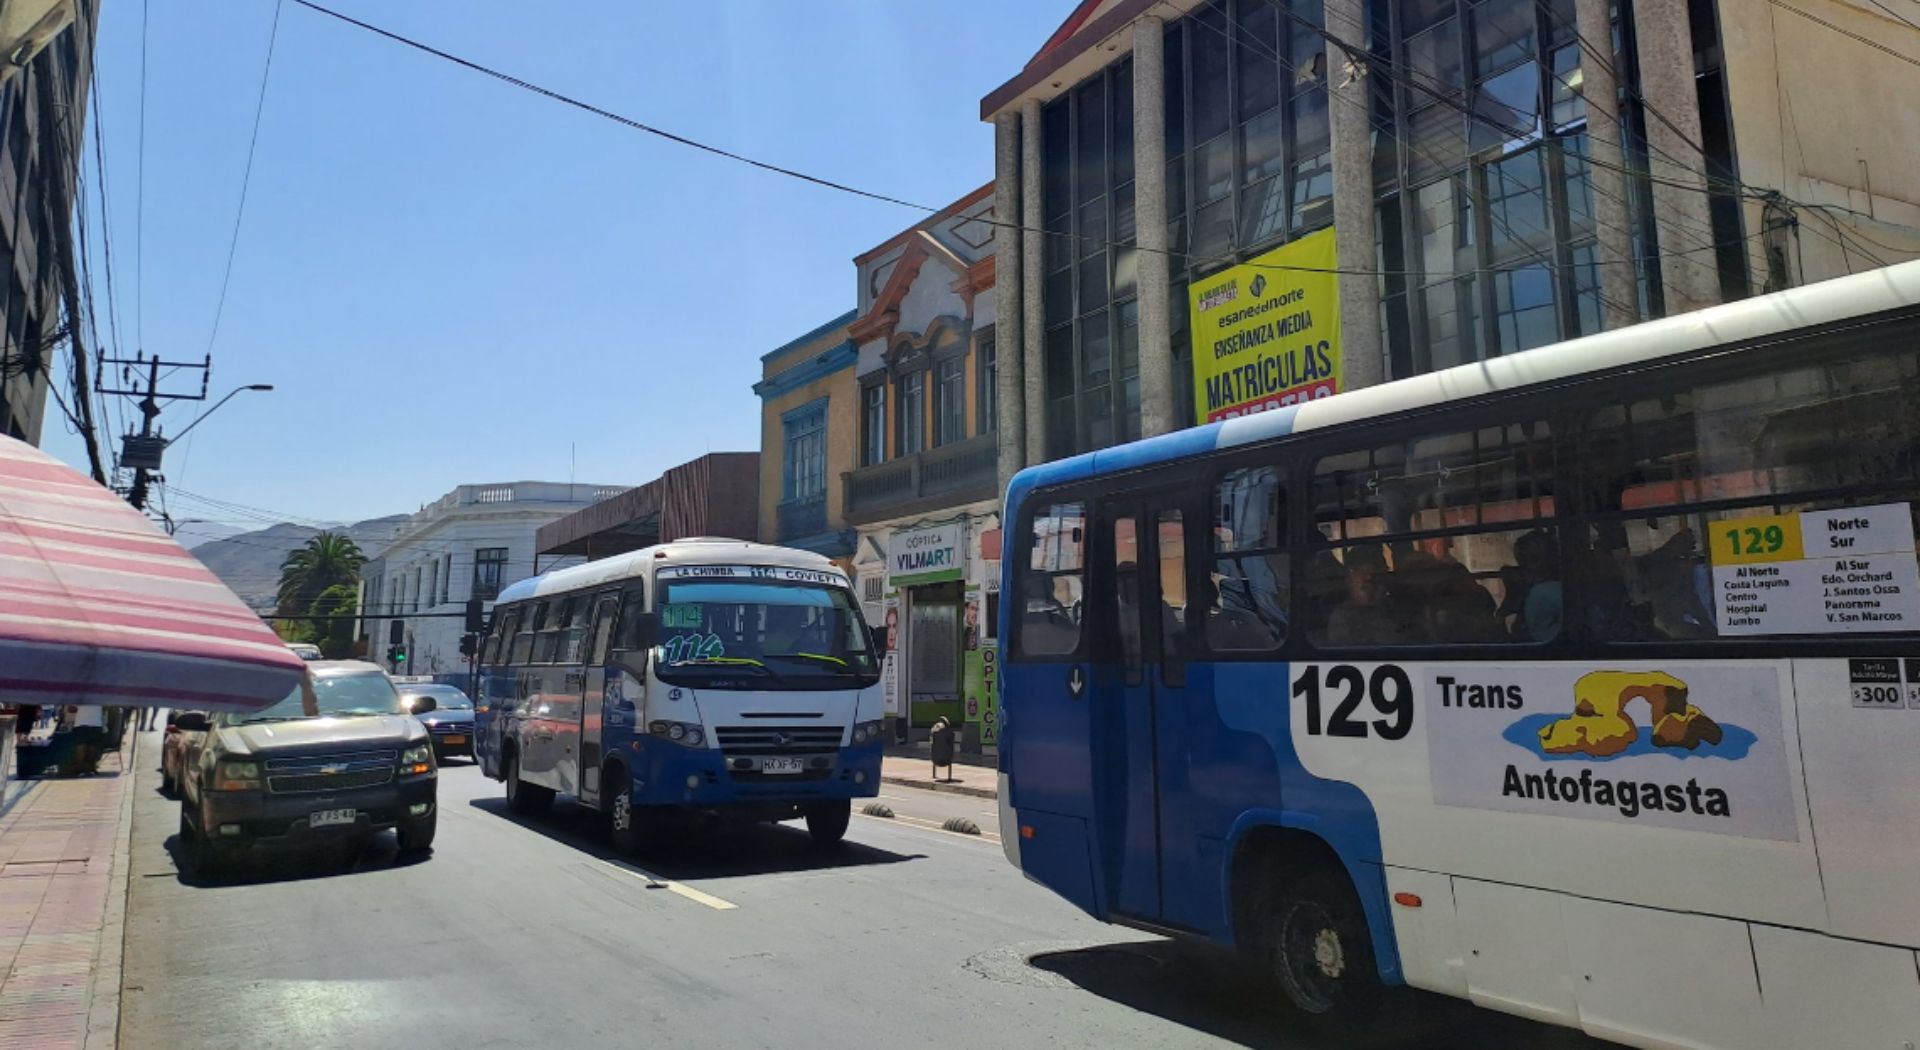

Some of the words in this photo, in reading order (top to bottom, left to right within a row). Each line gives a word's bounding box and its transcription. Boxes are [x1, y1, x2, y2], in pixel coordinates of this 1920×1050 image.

[1214, 325, 1274, 360] ENSEÑANZA
[1277, 310, 1313, 339] MEDIA
[1206, 340, 1332, 411] MATRÍCULAS
[1827, 518, 1870, 532] Norte
[1726, 525, 1784, 555] 129
[1830, 536, 1855, 548] Sur
[897, 547, 953, 570] VILMART
[676, 568, 689, 577] LA
[693, 567, 735, 577] CHIMBA
[1835, 561, 1848, 571] Al
[1850, 561, 1870, 571] Sur
[750, 567, 776, 579] 114
[1736, 568, 1748, 578] Al
[1749, 567, 1779, 577] Norte
[1847, 571, 1893, 583] Orchard
[1724, 580, 1751, 590] Costa
[1752, 578, 1789, 590] Laguna
[1725, 592, 1758, 602] Centro
[1824, 588, 1832, 598] J.
[1833, 586, 1871, 597] Santos
[1873, 585, 1900, 595] Ossa
[1726, 603, 1768, 615] Hospital
[1825, 600, 1881, 609] Panorama
[665, 606, 699, 625] 114
[1727, 616, 1761, 627] Jumbo
[1826, 614, 1837, 623] V.
[1839, 613, 1860, 623] San
[1862, 611, 1903, 622] Marcos
[665, 633, 725, 663] 114
[1436, 676, 1524, 710] Trans
[1854, 687, 1899, 703] $300
[1292, 664, 1414, 741] 129
[1502, 764, 1731, 818] Antofagasta
